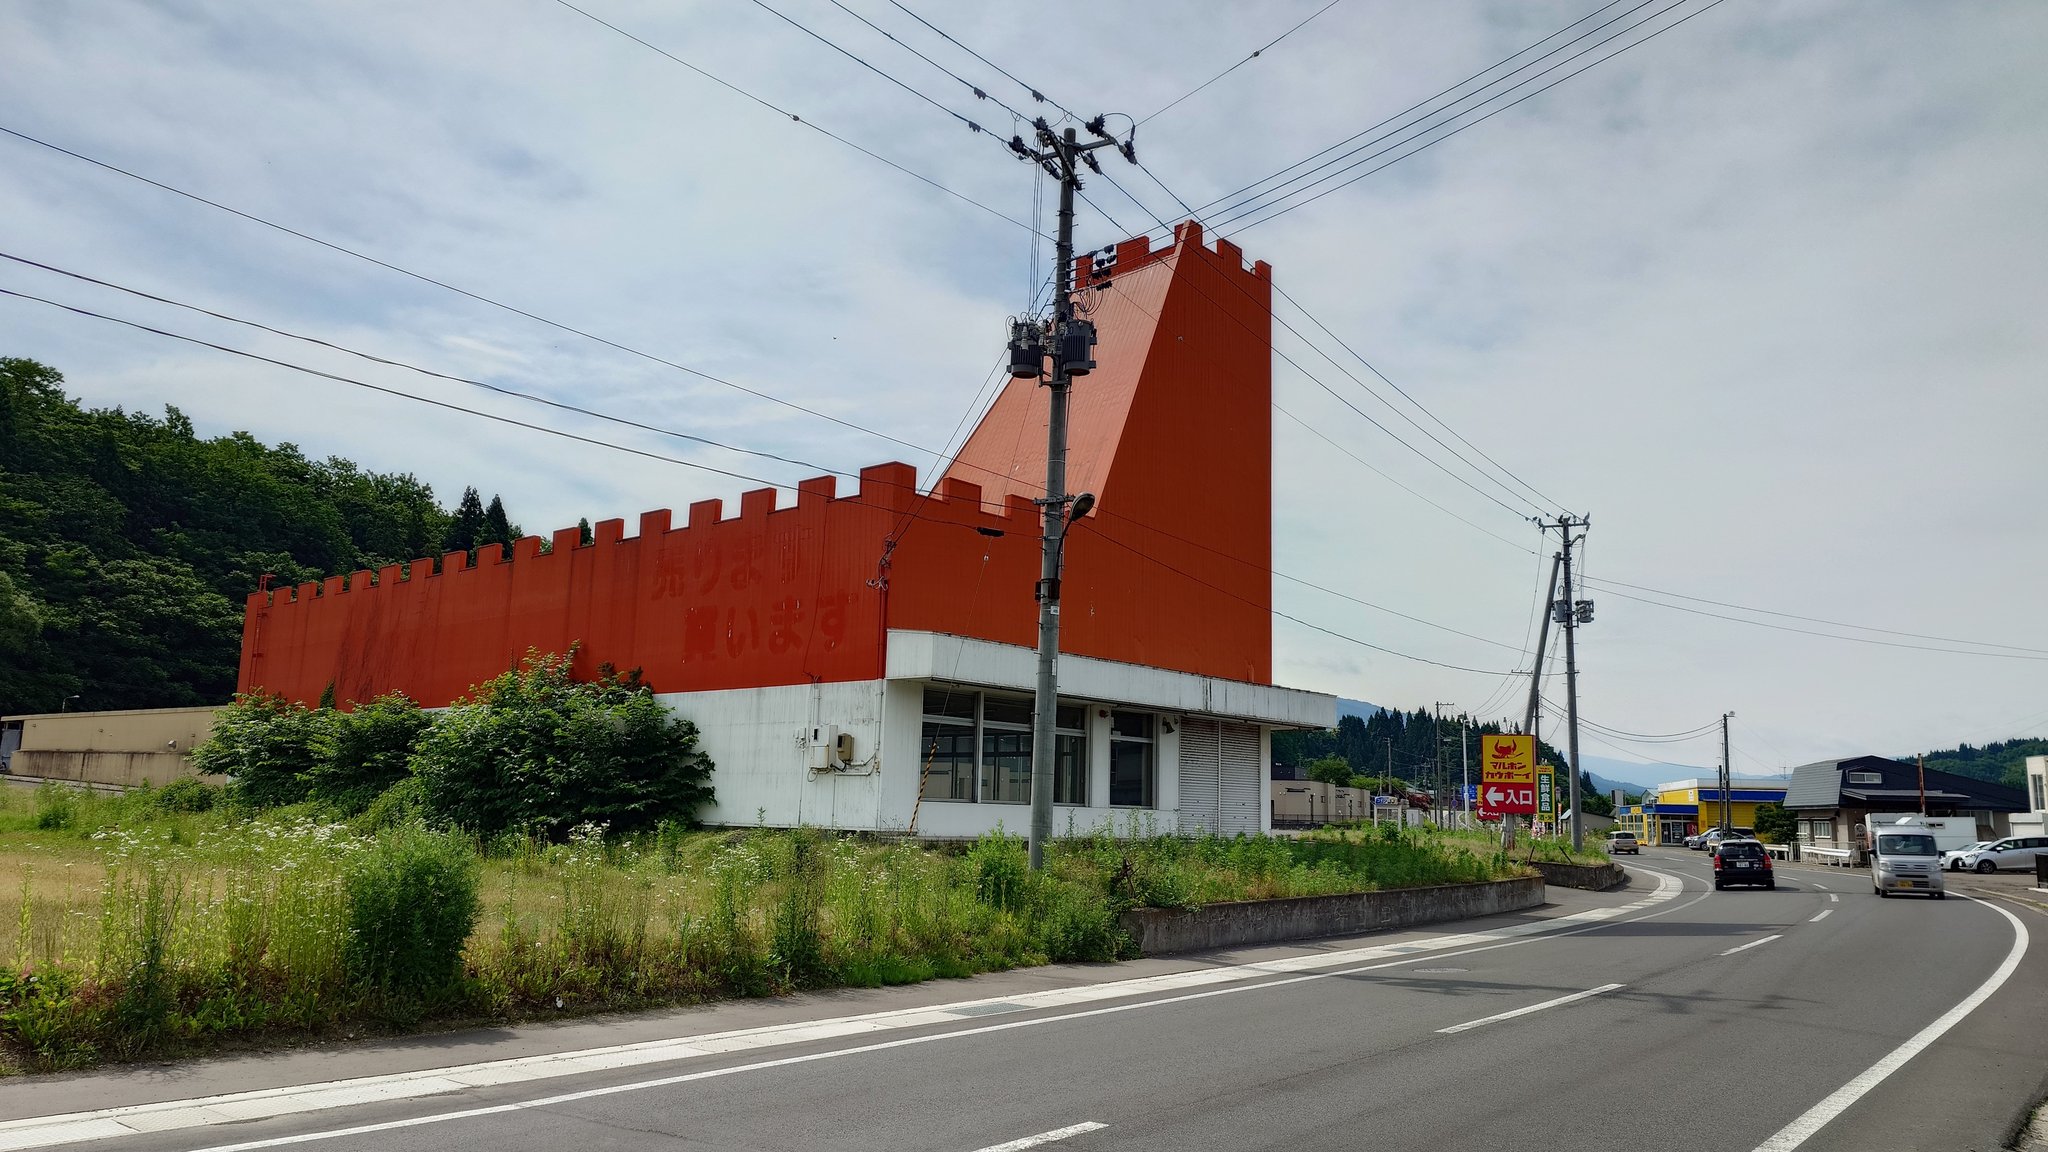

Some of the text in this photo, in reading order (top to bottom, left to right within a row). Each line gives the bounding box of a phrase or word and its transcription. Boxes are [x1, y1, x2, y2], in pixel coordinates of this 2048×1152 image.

[1506, 789, 1533, 805] 入口
[1540, 775, 1551, 811] 生鮮食品
